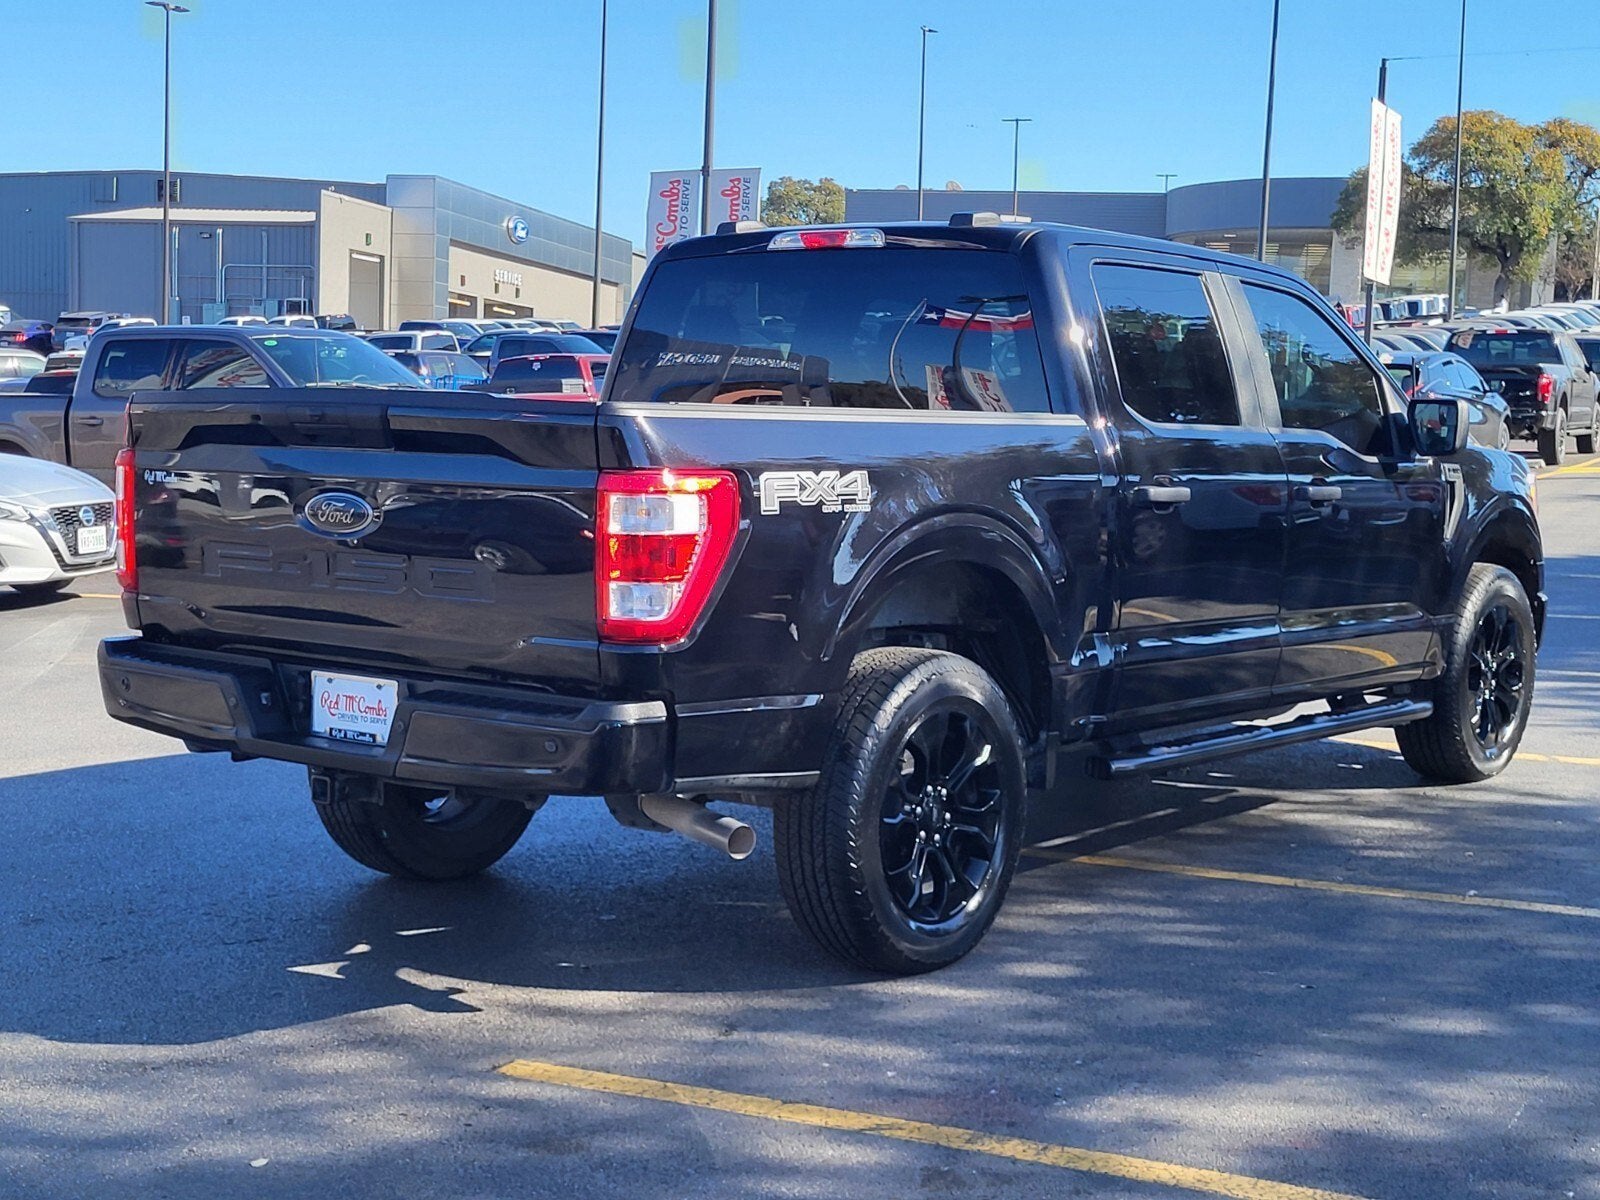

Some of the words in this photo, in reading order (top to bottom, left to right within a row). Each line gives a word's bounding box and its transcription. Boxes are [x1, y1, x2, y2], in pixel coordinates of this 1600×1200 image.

[680, 178, 691, 212] SERVE
[741, 177, 751, 211] SERVE
[680, 215, 689, 233] TO
[494, 269, 522, 286] SERVICE
[759, 470, 872, 515] FX4
[318, 500, 355, 524] Ford
[200, 540, 497, 603] F-150
[320, 690, 341, 716] Red
[337, 712, 359, 722] DRIVEN
[360, 715, 369, 723] TO
[369, 716, 388, 725] SERVE
